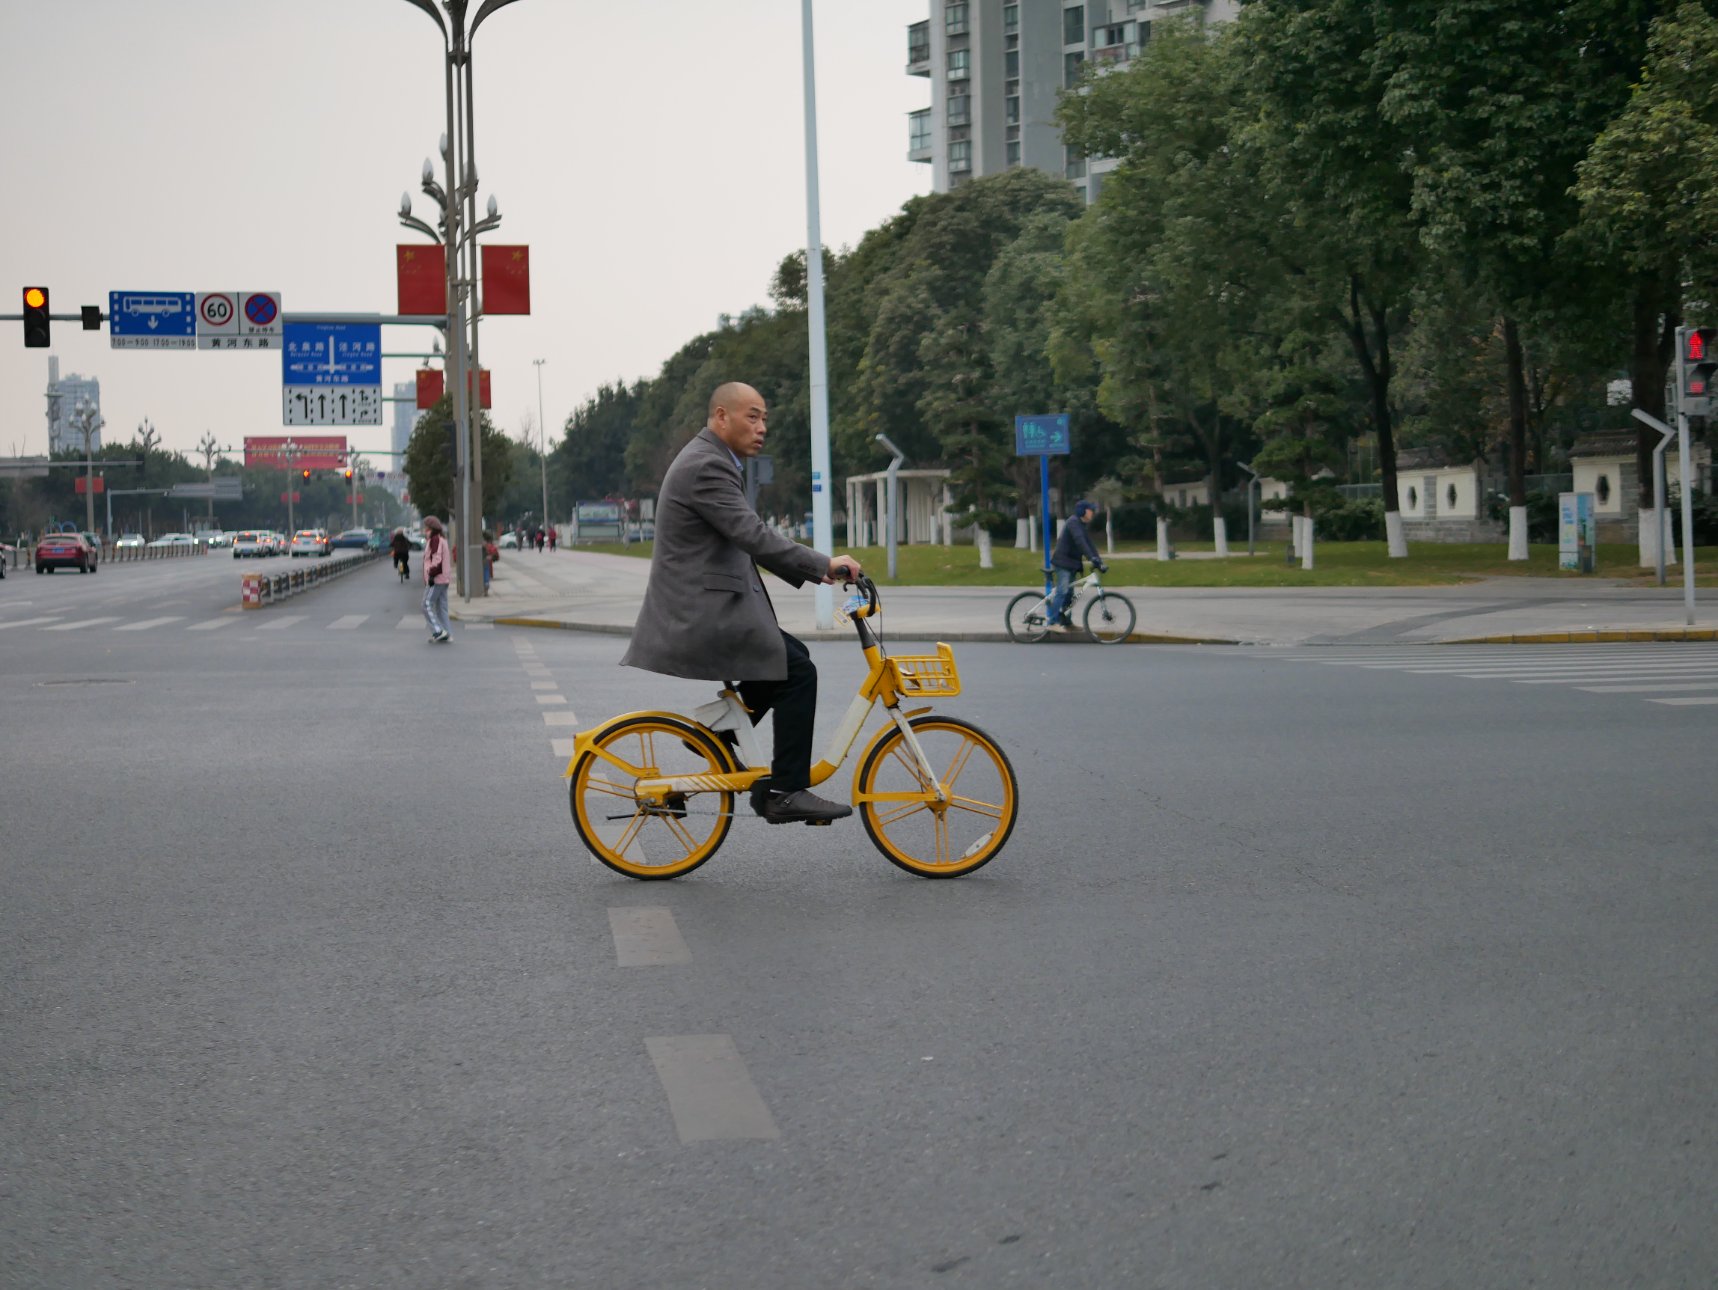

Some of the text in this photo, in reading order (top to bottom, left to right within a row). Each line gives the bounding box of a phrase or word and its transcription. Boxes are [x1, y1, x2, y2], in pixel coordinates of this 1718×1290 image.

[207, 302, 227, 318] 60
[211, 338, 269, 348] 黄河东路
